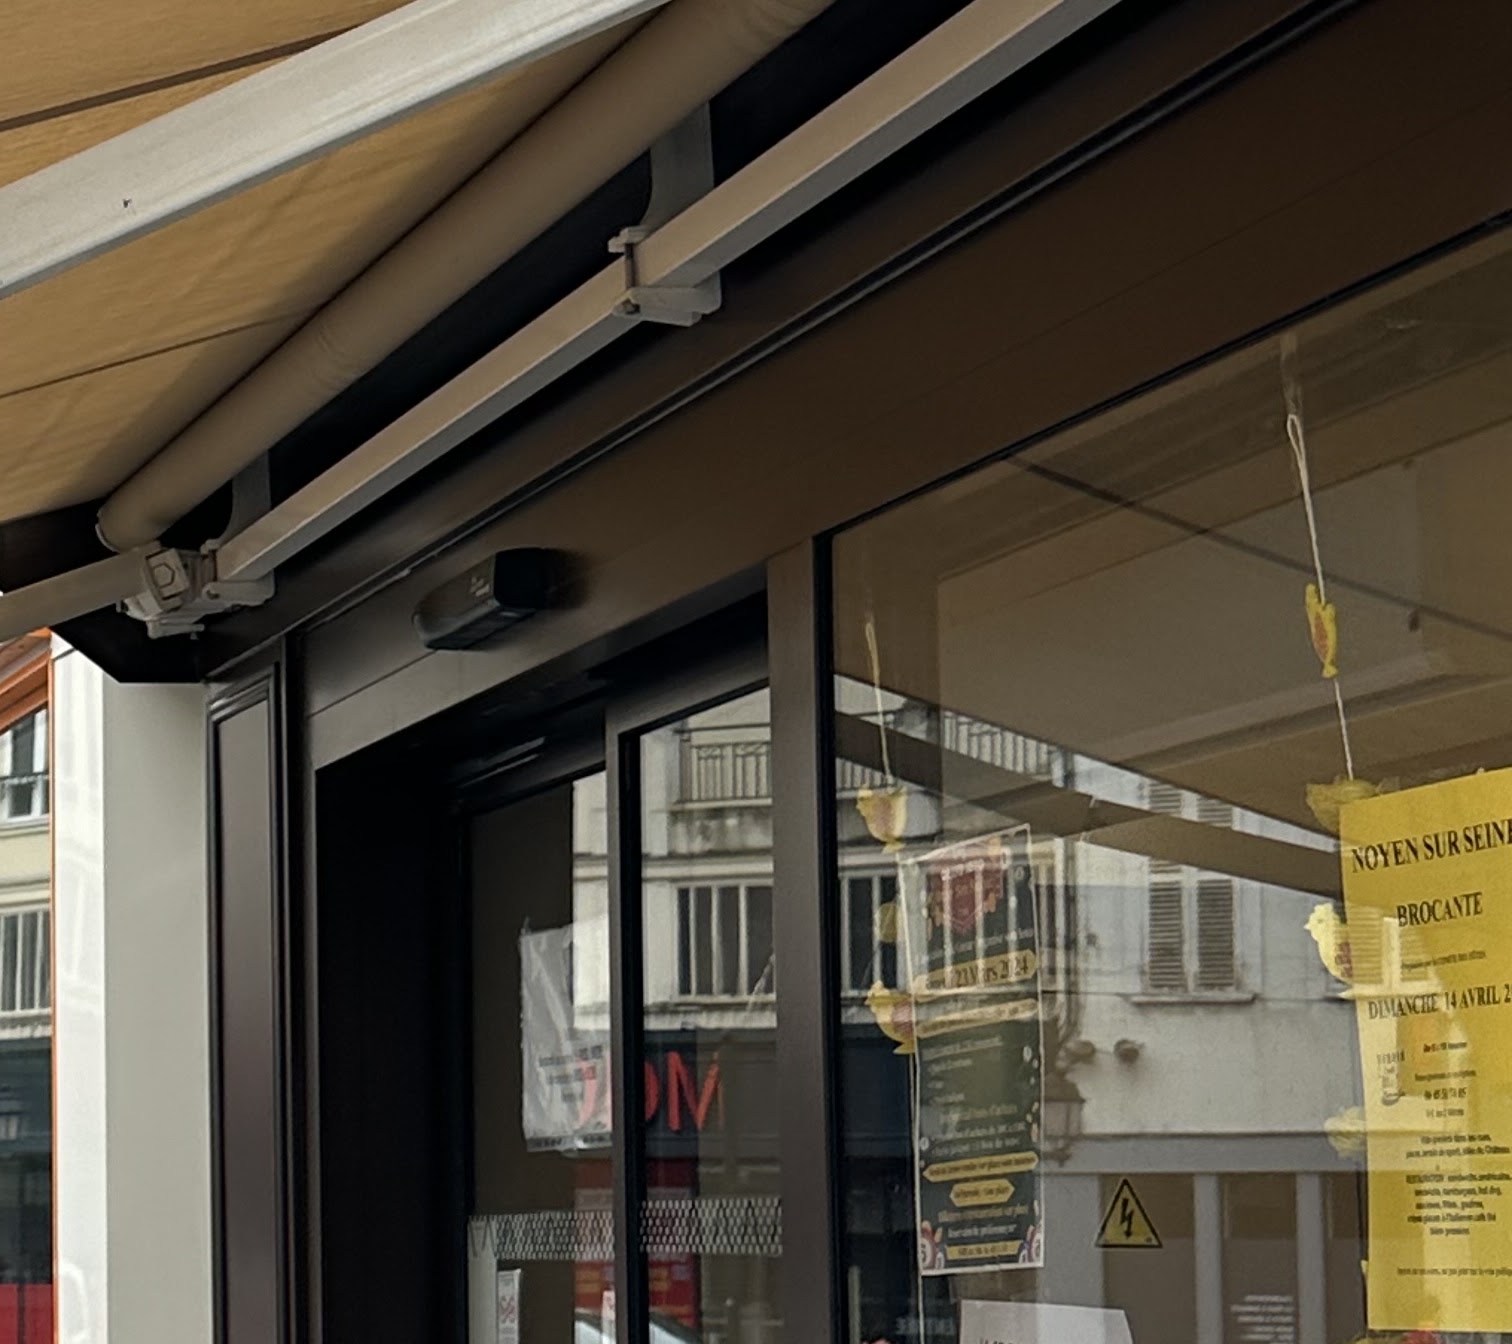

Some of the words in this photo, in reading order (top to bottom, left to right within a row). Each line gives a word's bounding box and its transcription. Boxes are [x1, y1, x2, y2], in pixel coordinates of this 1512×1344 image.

[1352, 837, 1419, 873] NOYEN
[1422, 830, 1461, 861] SUR
[1396, 892, 1483, 927] BROCANTE
[1368, 992, 1438, 1019] DIMANCHE
[1445, 990, 1458, 1010] 14
[1460, 985, 1500, 1008] AVRIL
